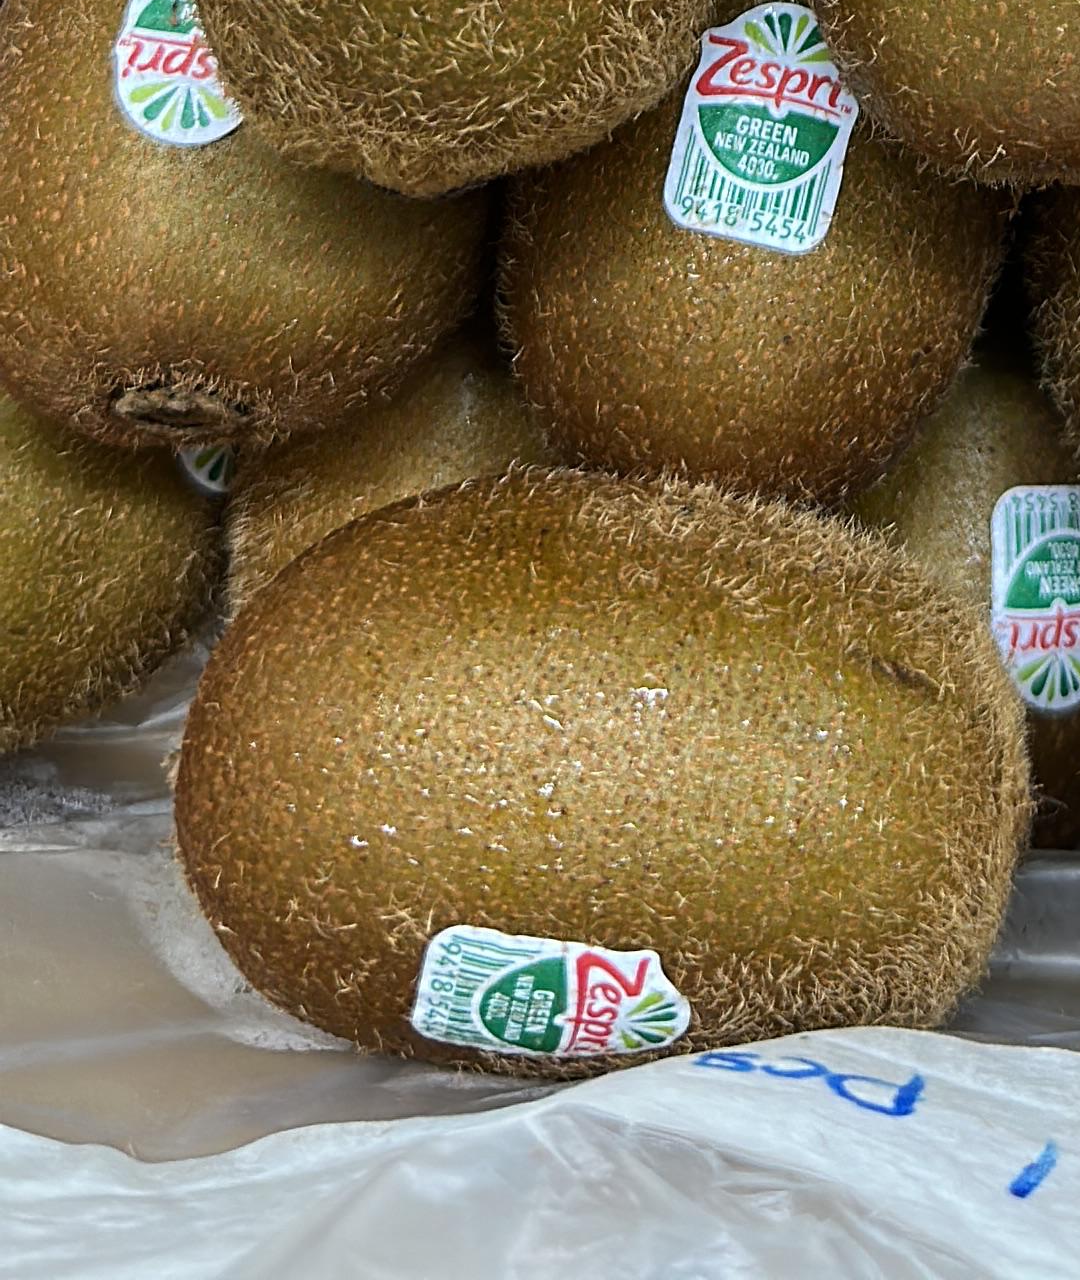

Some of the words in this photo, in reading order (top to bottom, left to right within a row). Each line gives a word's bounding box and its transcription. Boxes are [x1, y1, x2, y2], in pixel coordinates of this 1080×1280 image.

[696, 34, 842, 117] Zespri
[714, 130, 747, 150] NEW
[748, 137, 810, 166] ZEALAND
[736, 115, 799, 146] GREEN
[682, 195, 738, 226] 9418
[750, 214, 807, 243] 5454
[1012, 491, 1058, 511] 5454
[431, 941, 462, 992] 9418
